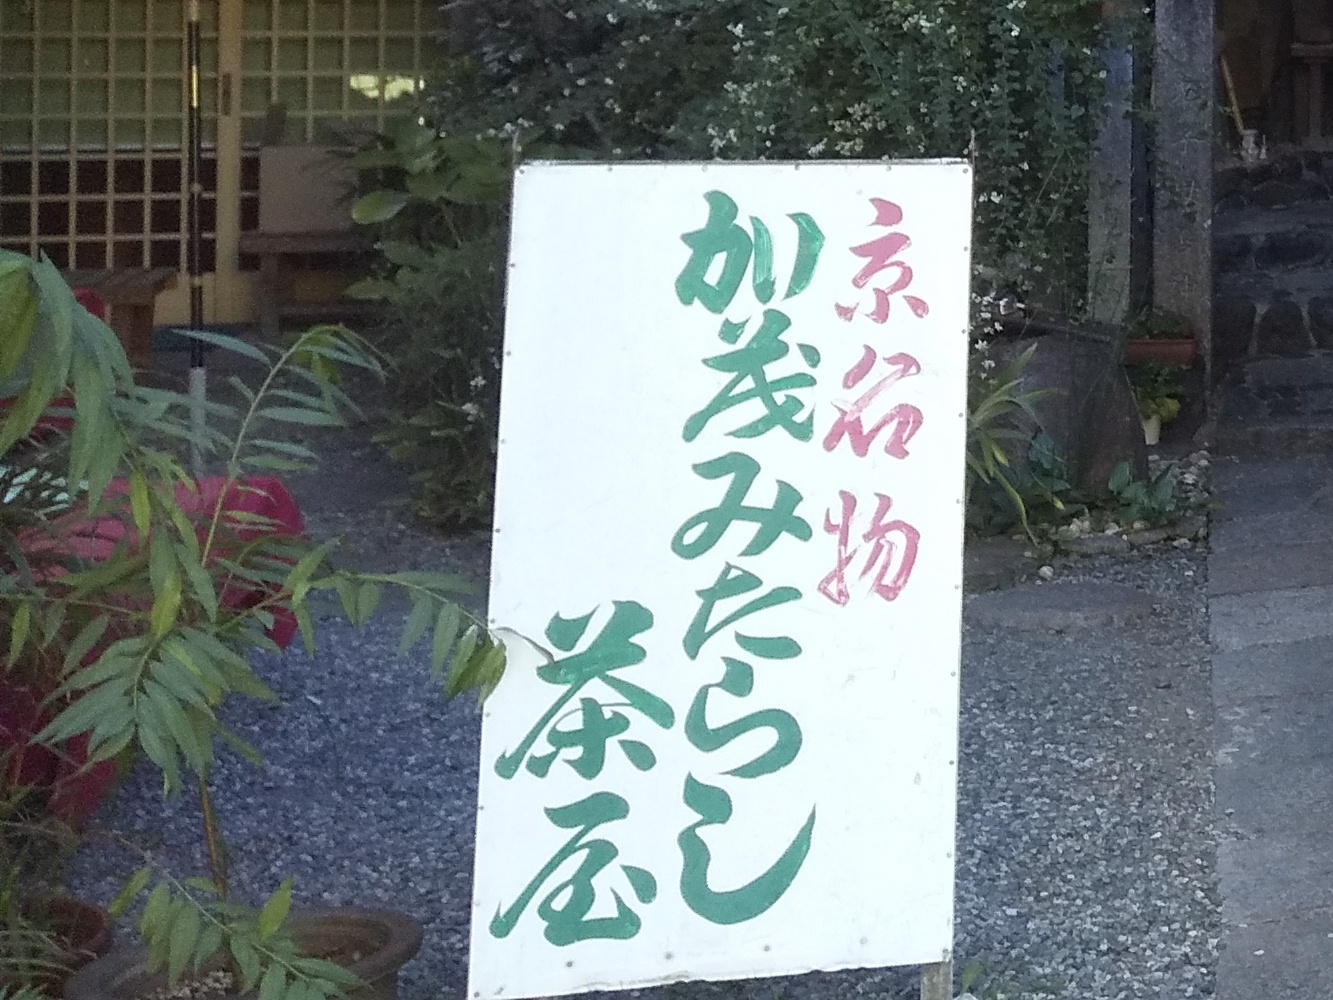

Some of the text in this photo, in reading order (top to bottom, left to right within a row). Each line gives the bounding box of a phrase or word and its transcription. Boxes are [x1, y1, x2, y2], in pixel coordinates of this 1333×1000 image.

[671, 189, 826, 925] 加茂みたらし
[817, 197, 930, 606] 京名物
[490, 599, 675, 947] 茶屋
